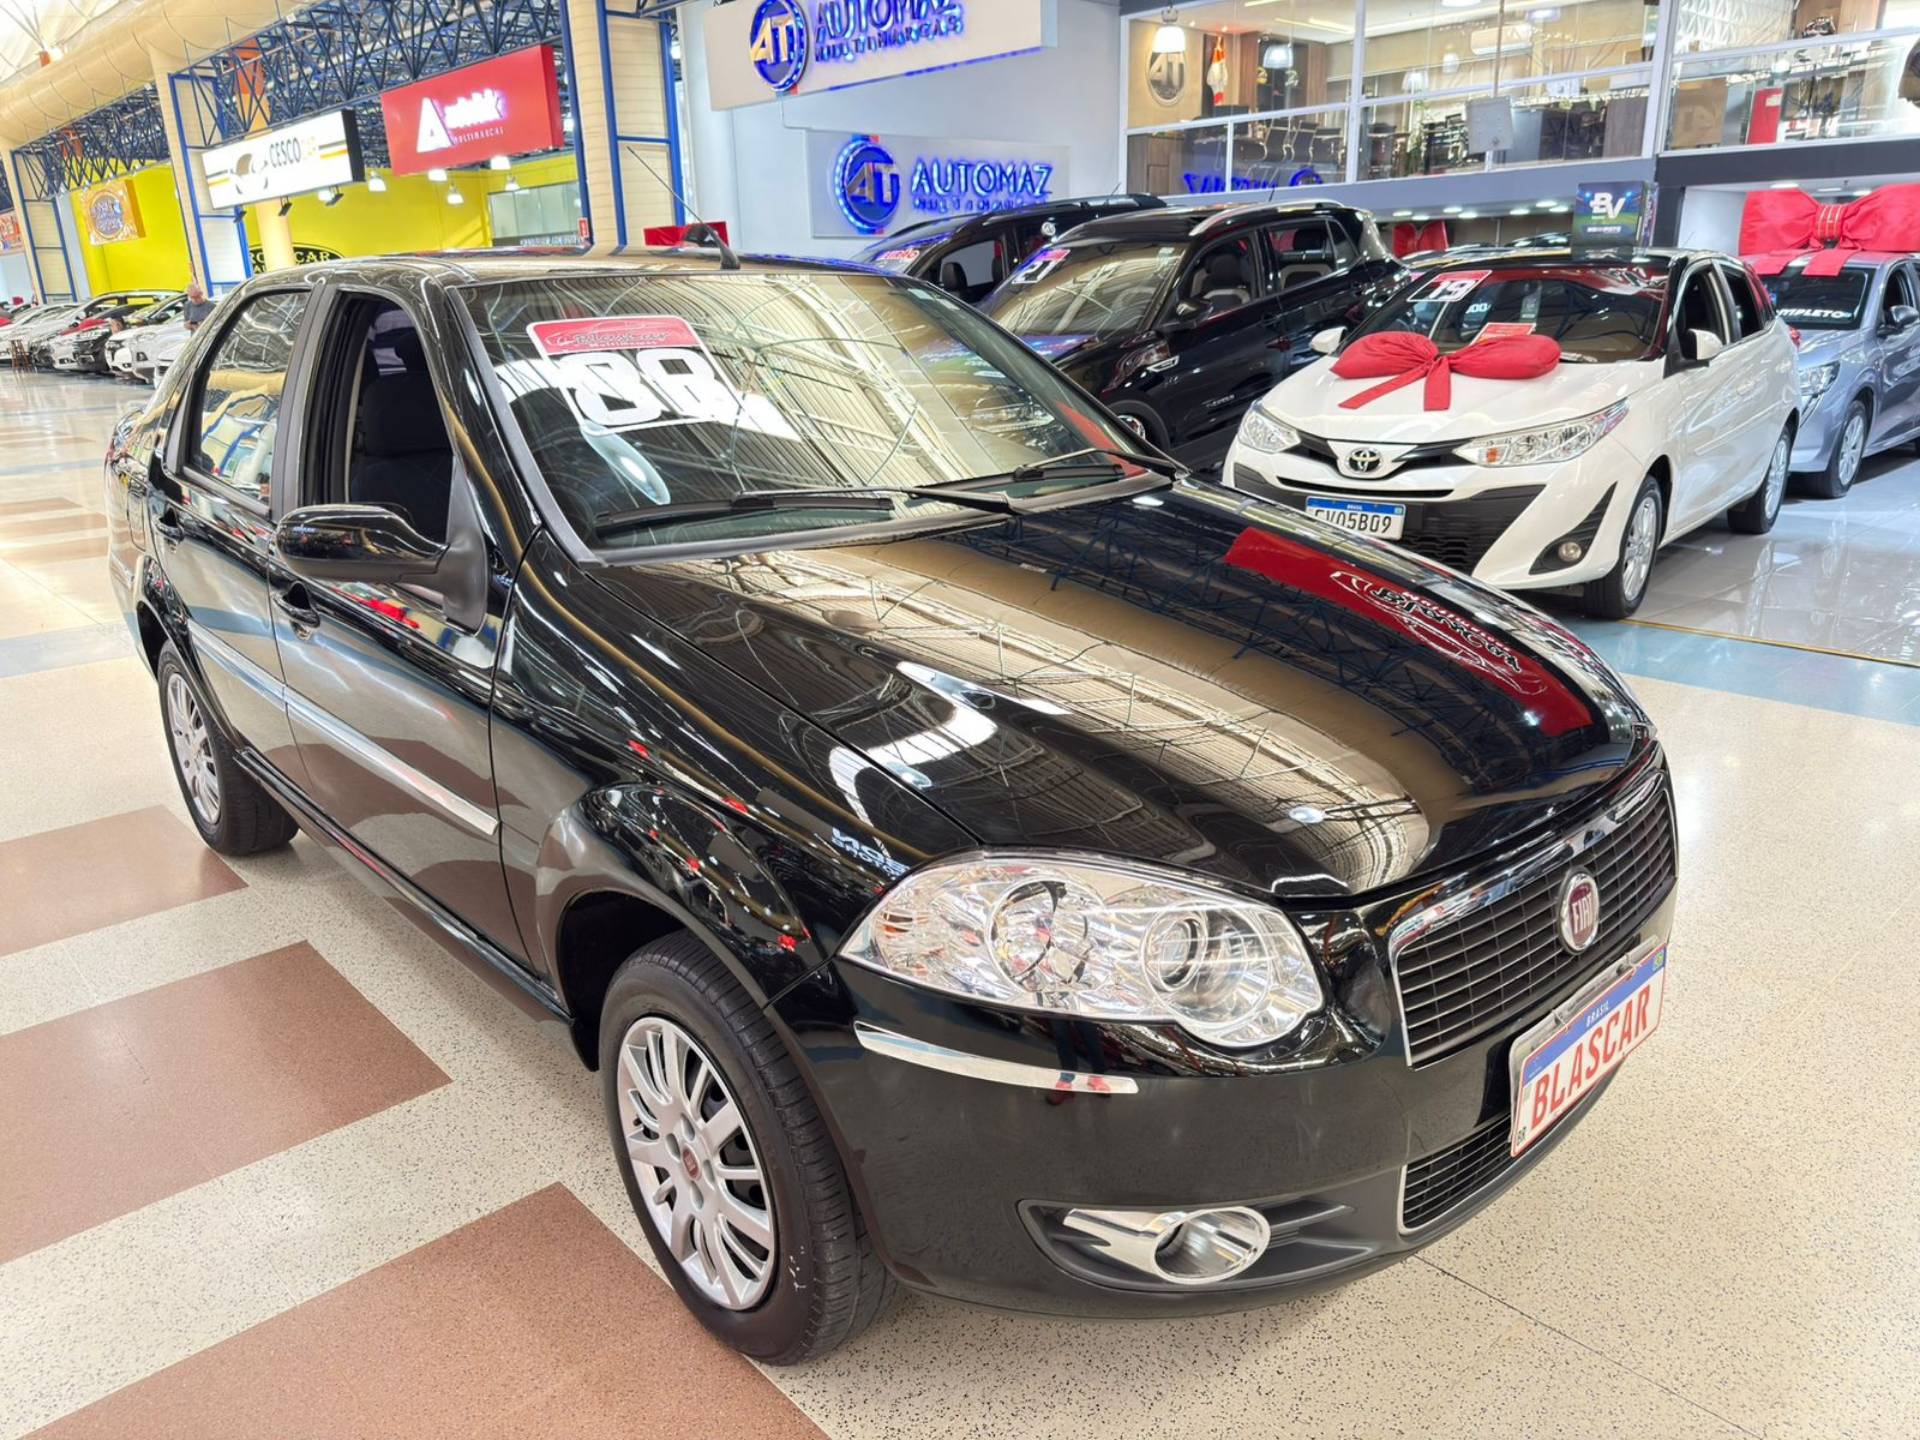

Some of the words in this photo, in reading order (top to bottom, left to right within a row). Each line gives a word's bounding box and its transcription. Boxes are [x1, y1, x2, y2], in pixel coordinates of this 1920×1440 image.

[911, 158, 1053, 197] AUTOMAZ
[1571, 891, 1593, 935] FIAT
[1585, 1000, 1609, 1028] BRASIL
[1531, 985, 1651, 1131] BLASCAR
